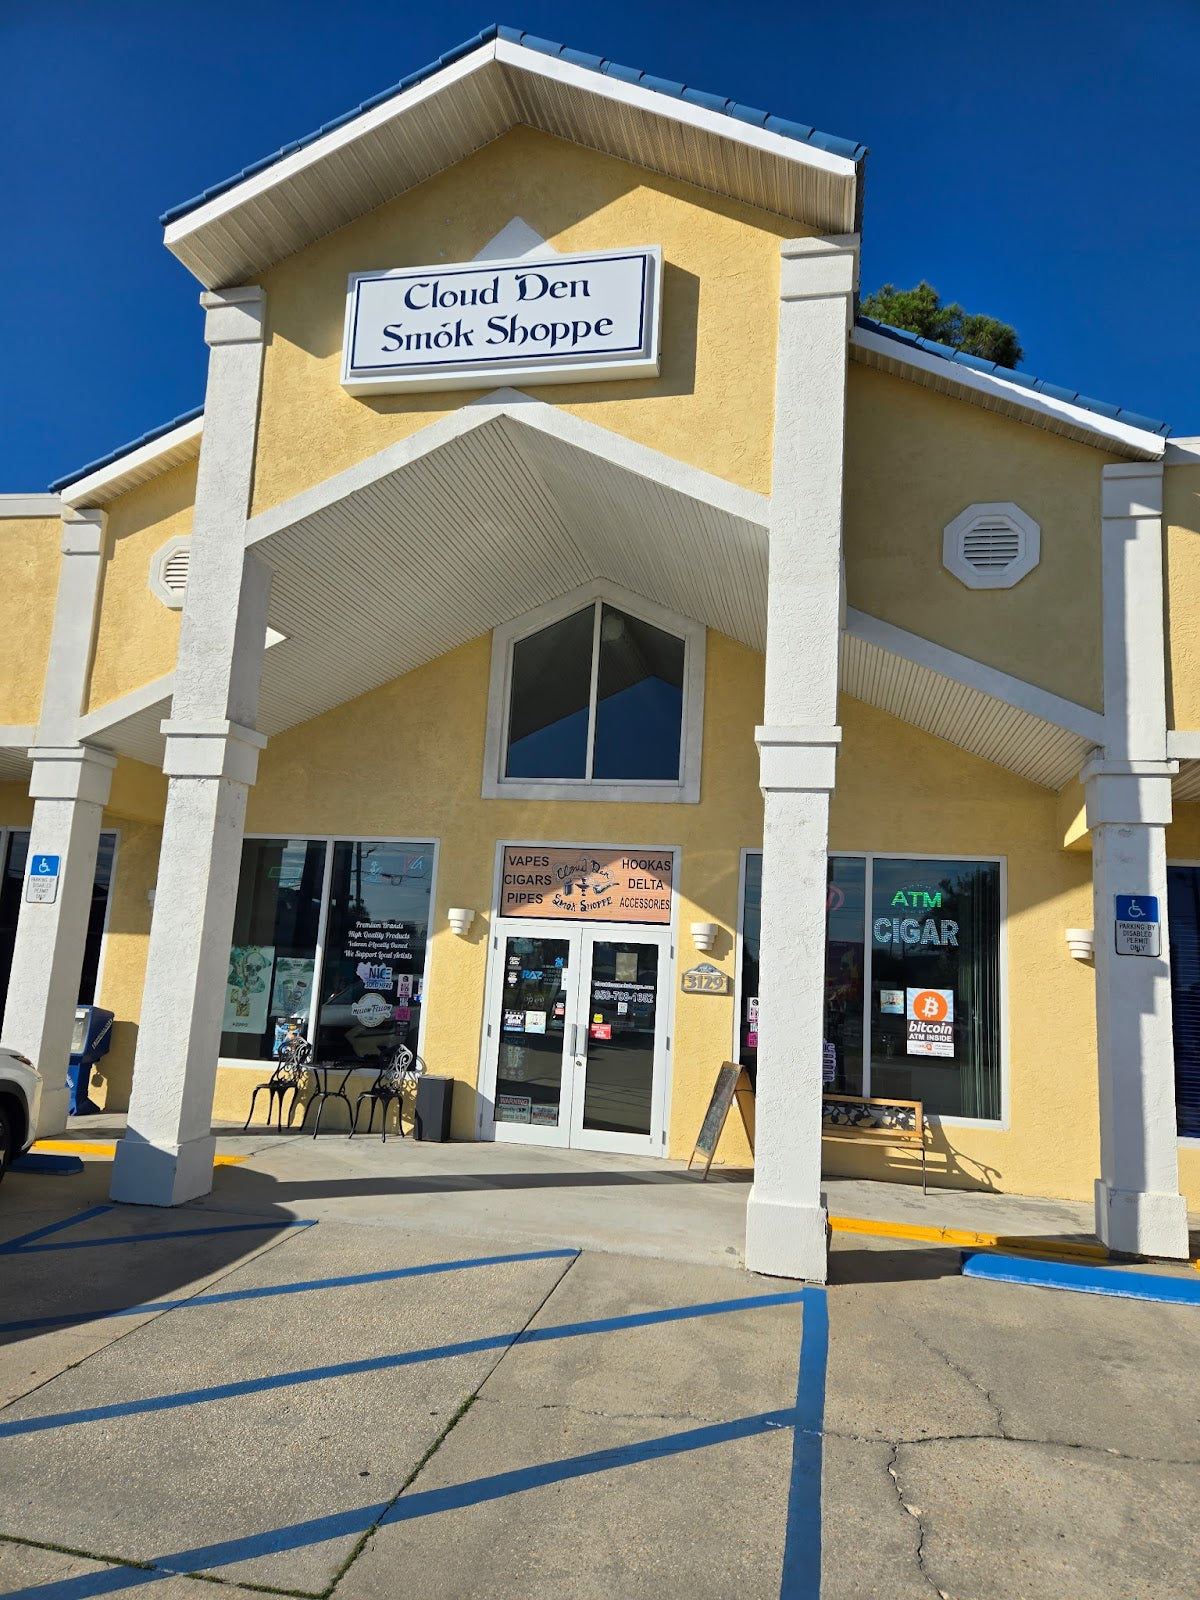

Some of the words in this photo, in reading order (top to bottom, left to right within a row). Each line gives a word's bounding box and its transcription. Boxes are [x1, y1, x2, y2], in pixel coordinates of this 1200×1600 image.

[404, 276, 499, 310] Cloud
[514, 273, 591, 302] Den
[380, 318, 474, 352] Smók
[485, 313, 613, 349] Shoppe
[508, 855, 550, 867] VAPES
[621, 858, 671, 871] HOOKAS
[504, 873, 552, 886] CIGARS
[627, 877, 664, 890] DELTA
[506, 892, 544, 904] PIPES
[619, 896, 670, 910] ACCESSORIES
[891, 890, 941, 907] ATM
[348, 930, 362, 939] High
[385, 931, 410, 939] Products
[874, 917, 959, 946] CIGAR
[354, 950, 377, 959] Support
[369, 967, 391, 980] NICE
[686, 974, 723, 990] 3129
[909, 1020, 952, 1034] bitcoin
[926, 1034, 952, 1042] INSIDE
[500, 1096, 528, 1105] WARNING
